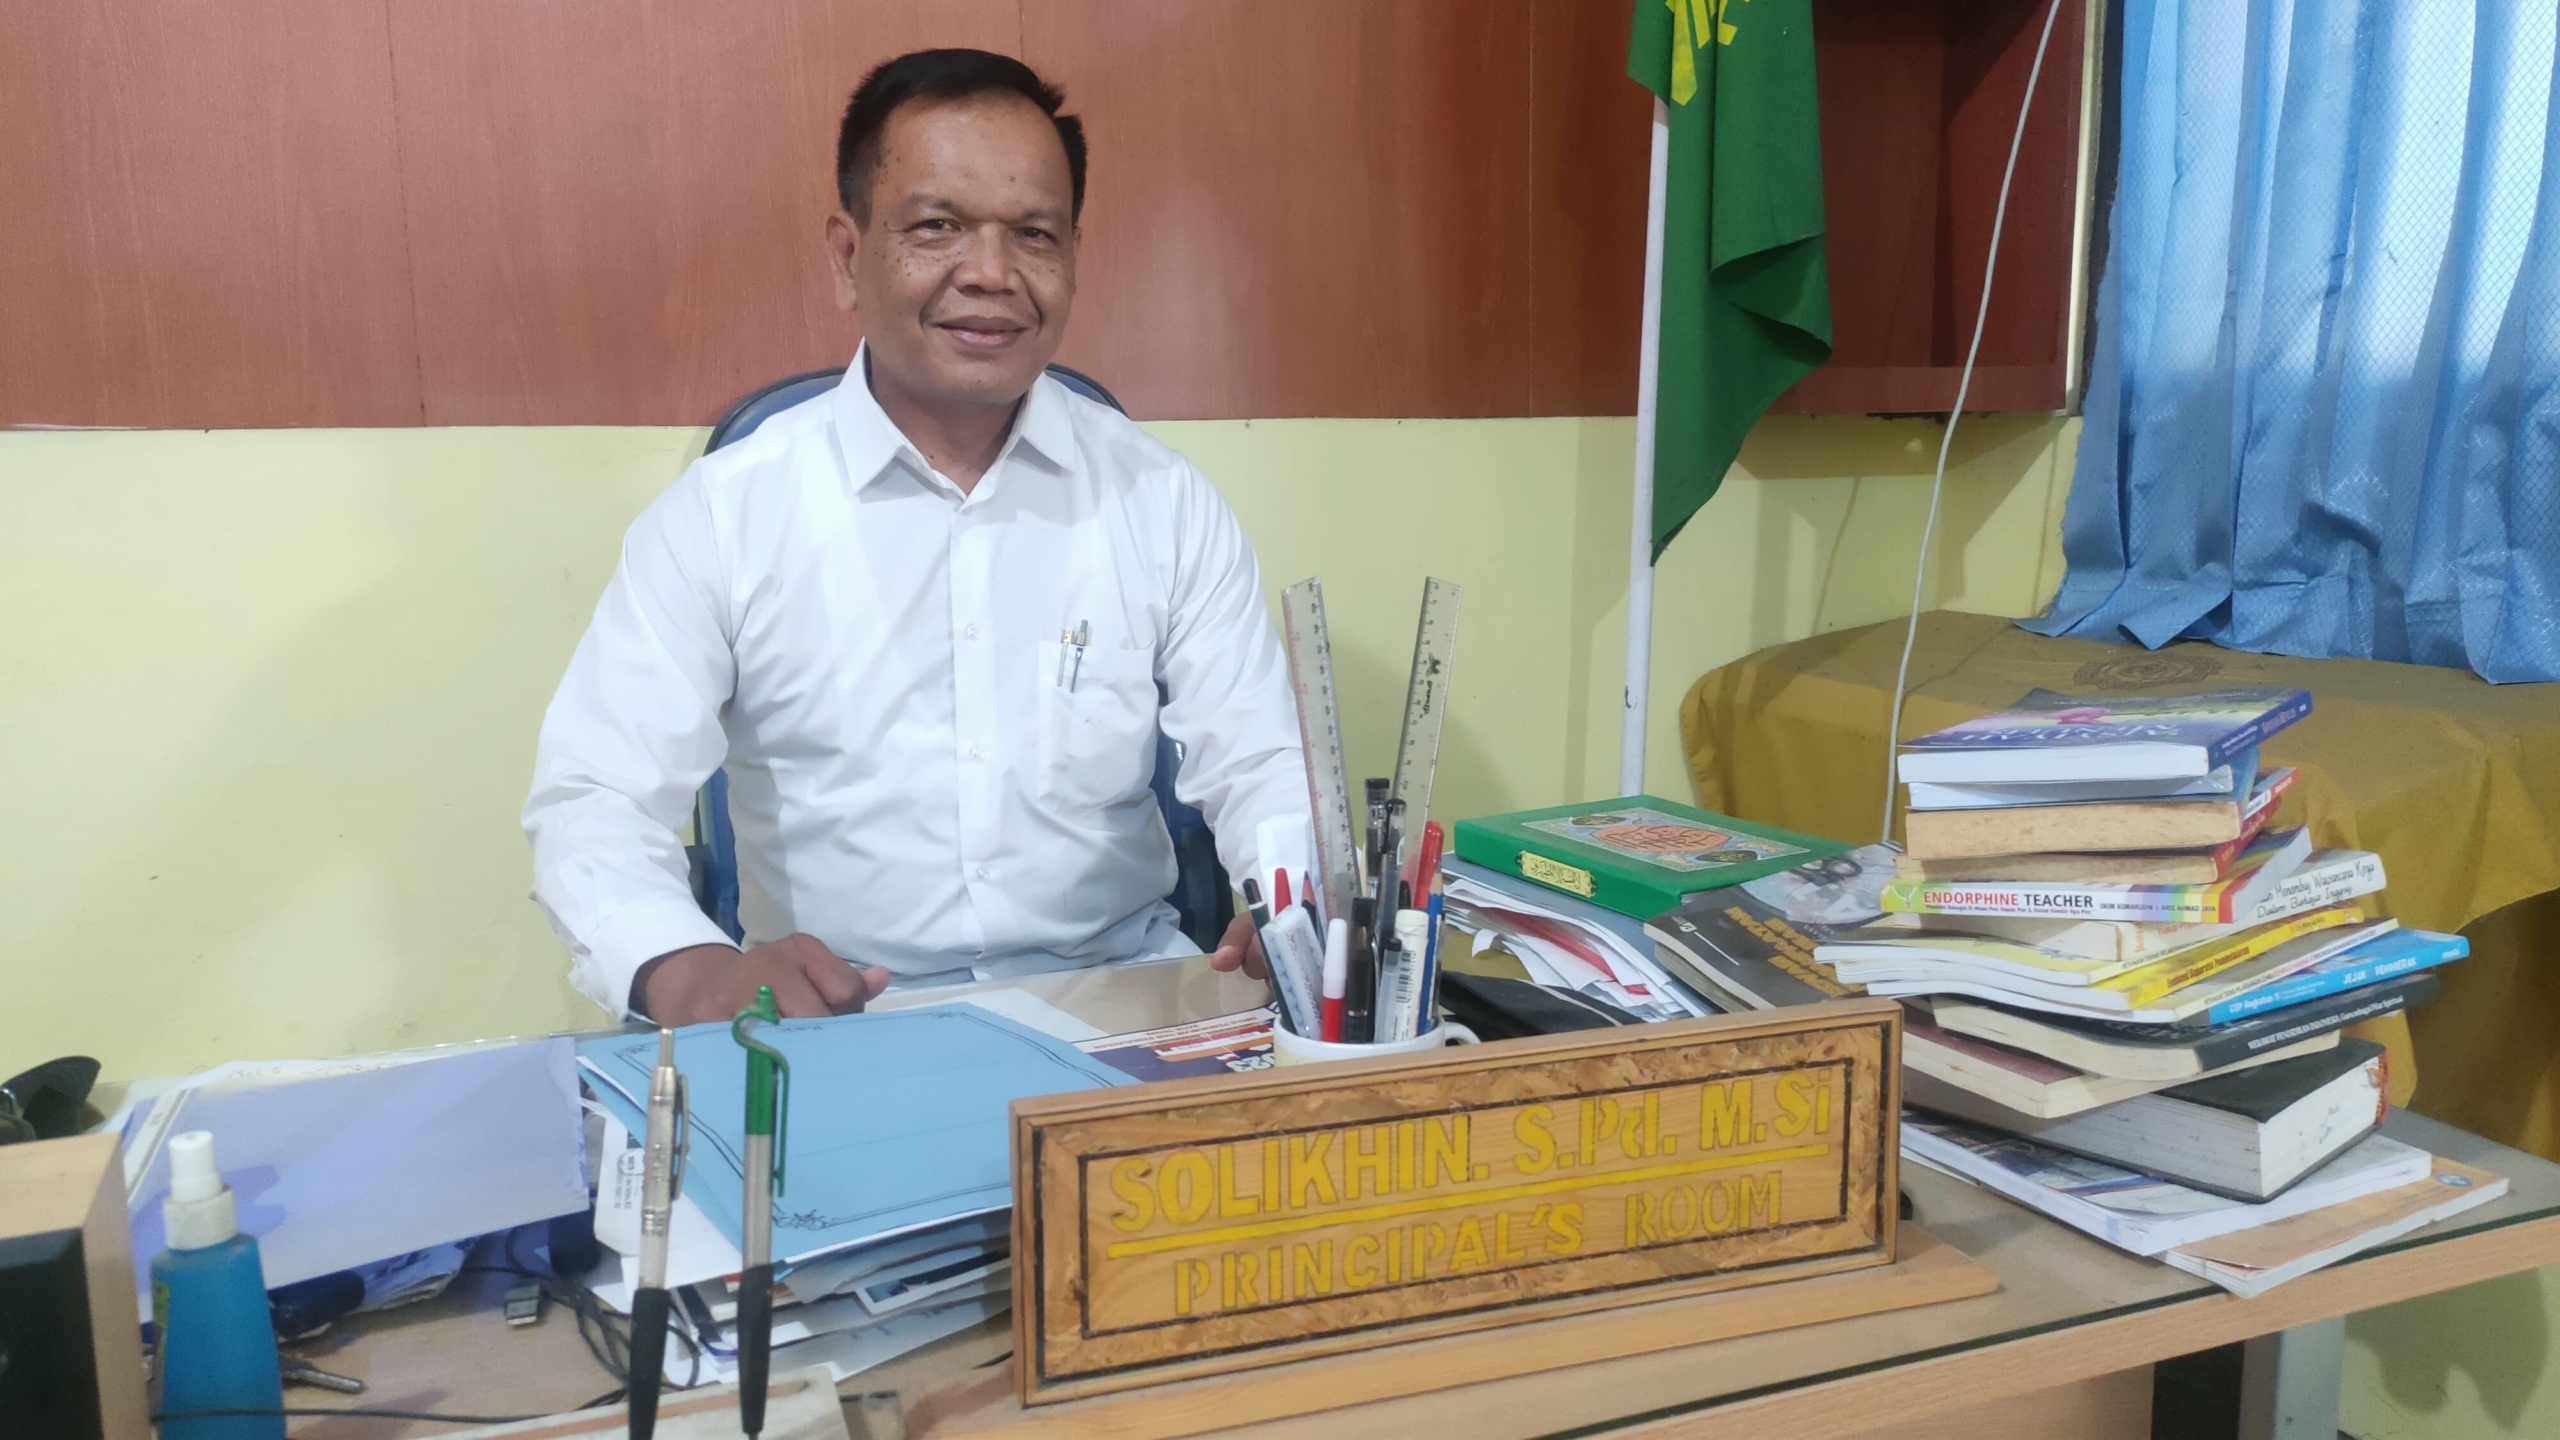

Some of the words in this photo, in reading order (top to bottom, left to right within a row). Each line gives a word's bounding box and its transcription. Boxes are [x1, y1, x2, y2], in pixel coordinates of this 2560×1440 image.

[1923, 891, 2019, 906] ENDORPHINE
[2024, 894, 2093, 908] TEACHER
[1110, 1113, 1491, 1232] SOLIKHIN.
[1513, 1090, 1678, 1175] S.Pd.
[1699, 1067, 1833, 1150] M.Si
[1174, 1201, 1585, 1317] PRINCIPAL'S
[1624, 1169, 1783, 1248] ROOM
